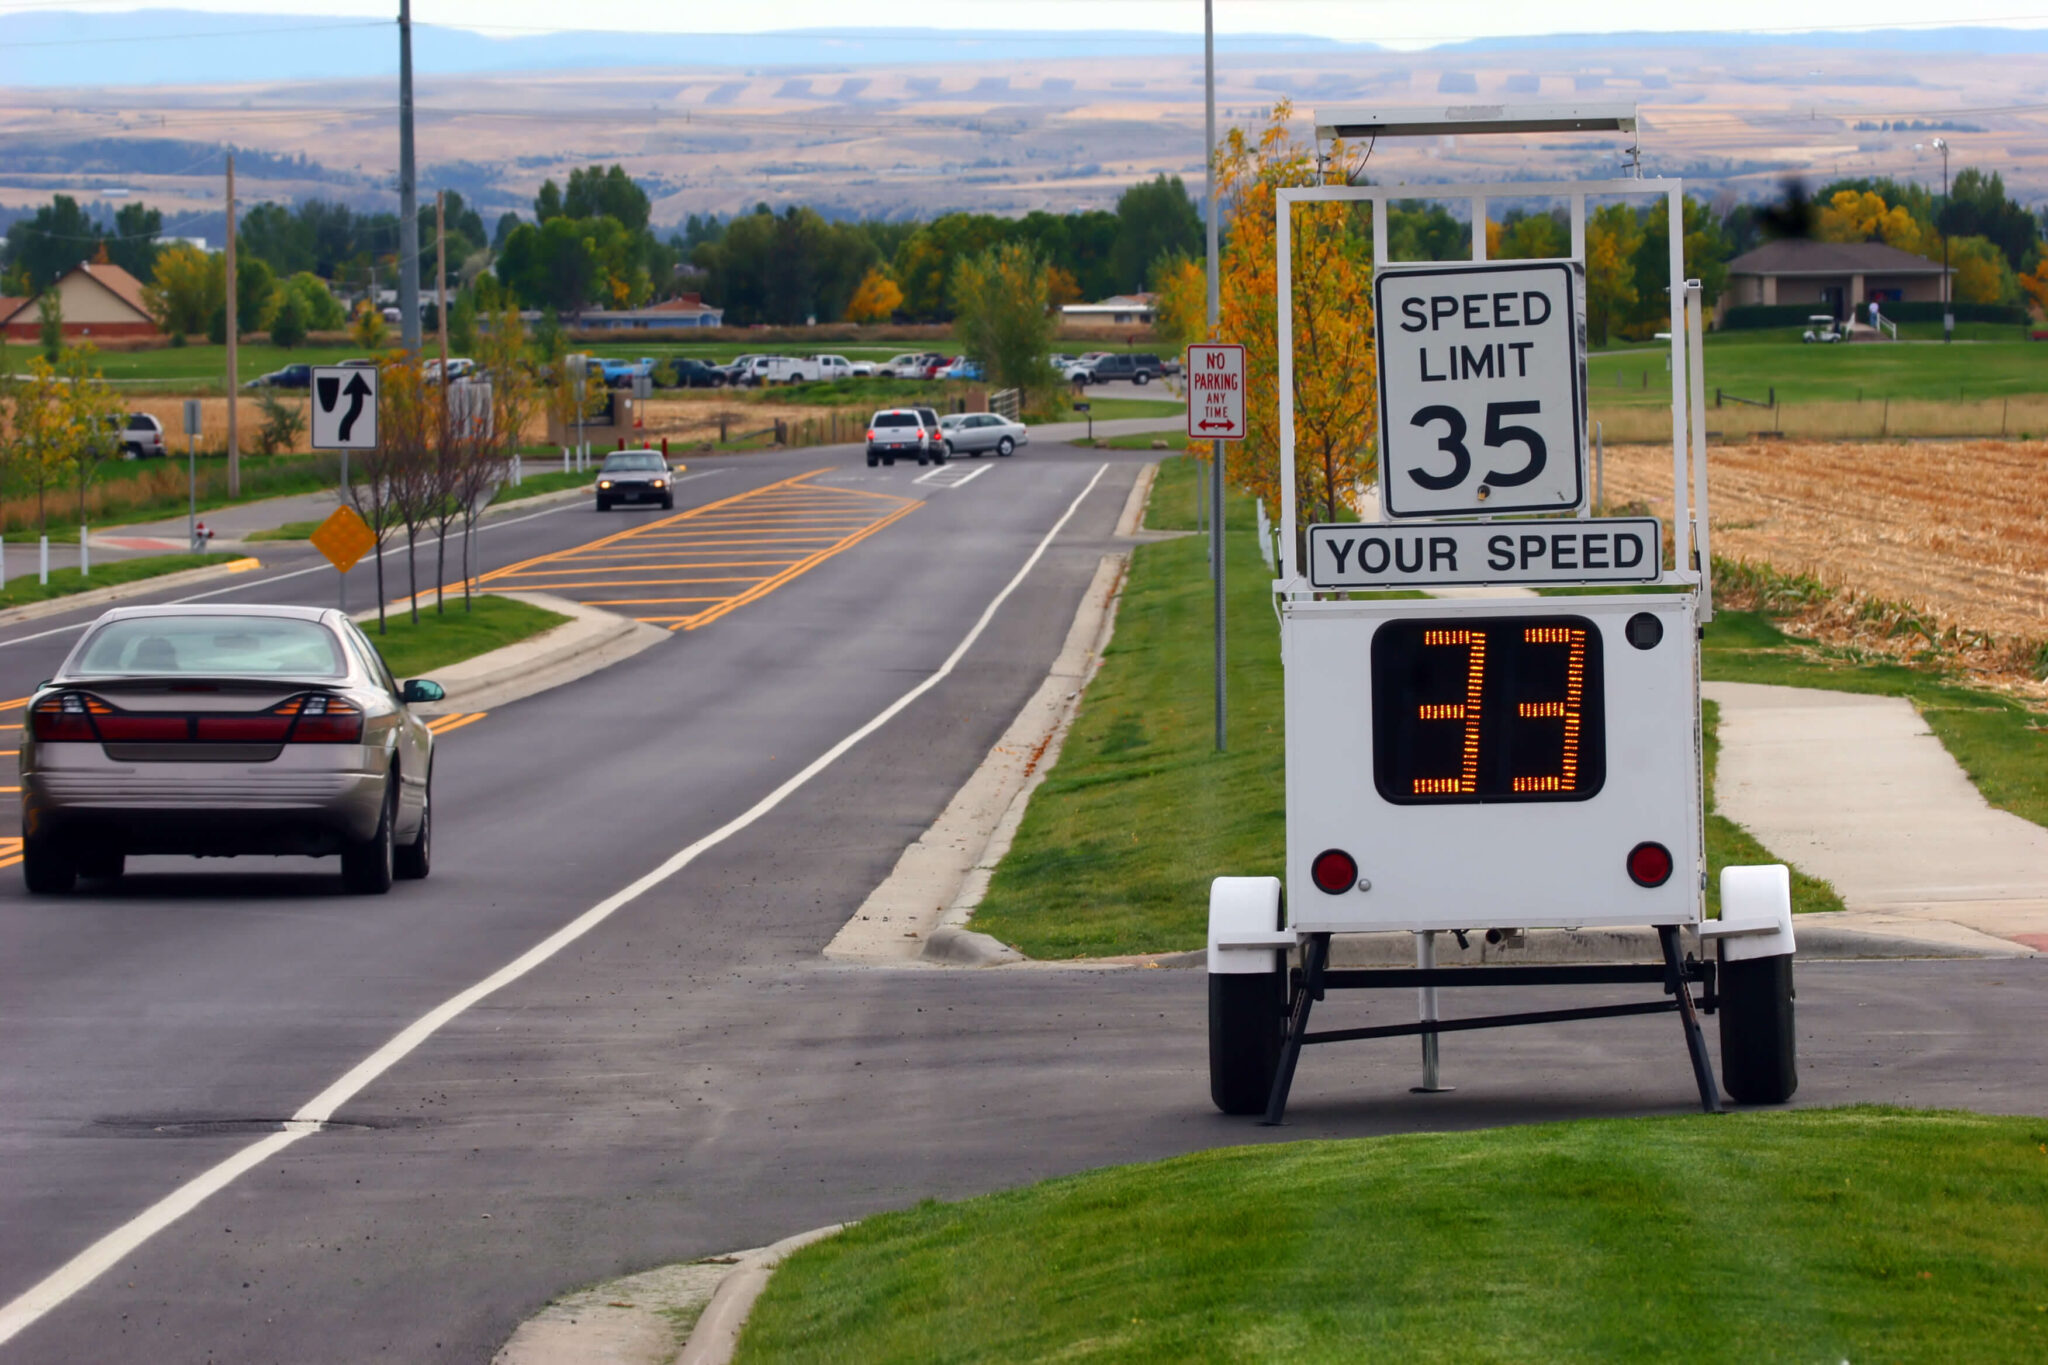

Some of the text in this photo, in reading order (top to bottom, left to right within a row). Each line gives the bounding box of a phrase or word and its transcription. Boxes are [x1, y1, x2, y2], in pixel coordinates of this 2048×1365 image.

[1400, 291, 1552, 333] SPEED
[1206, 352, 1225, 369] NO
[1420, 341, 1534, 382] LIMIT
[1194, 373, 1238, 390] PARKING
[1206, 392, 1226, 404] ANY
[1204, 406, 1228, 418] TIME
[1407, 400, 1548, 490] 35
[1325, 533, 1644, 574] YOUR SPEED
[1412, 628, 1586, 794] 33
